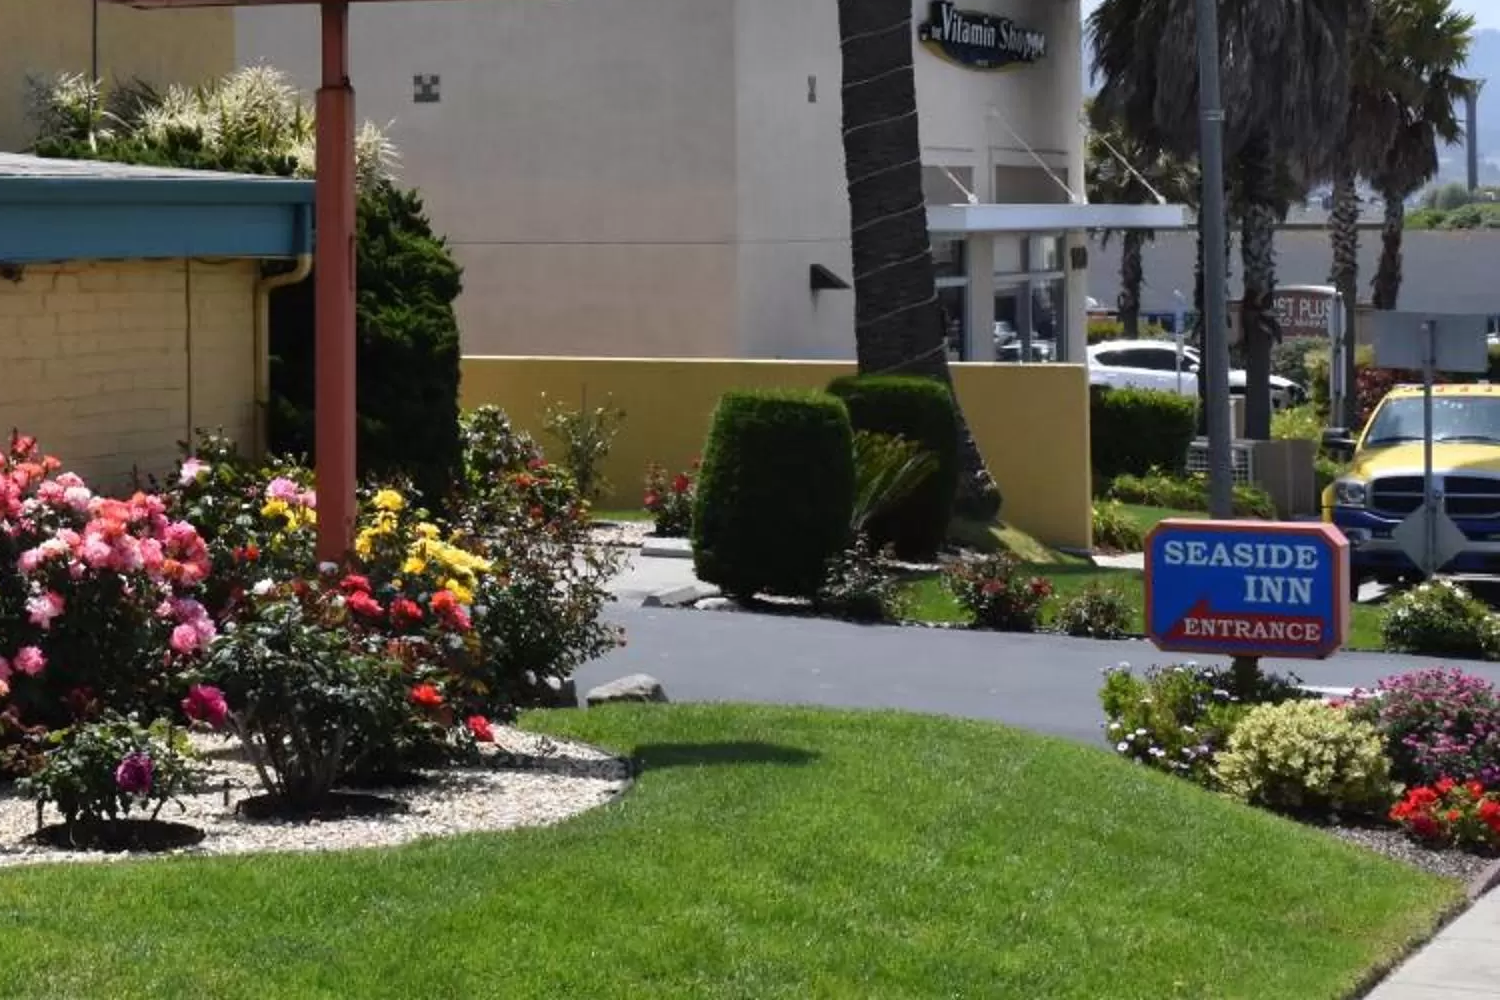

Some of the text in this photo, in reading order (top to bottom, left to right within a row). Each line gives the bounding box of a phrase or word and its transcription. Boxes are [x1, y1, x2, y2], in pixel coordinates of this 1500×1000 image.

[941, 3, 996, 47] Vitamin
[1164, 540, 1319, 570] SEASIDE
[1243, 575, 1314, 605] INN
[1183, 617, 1321, 642] ENTRANCE
